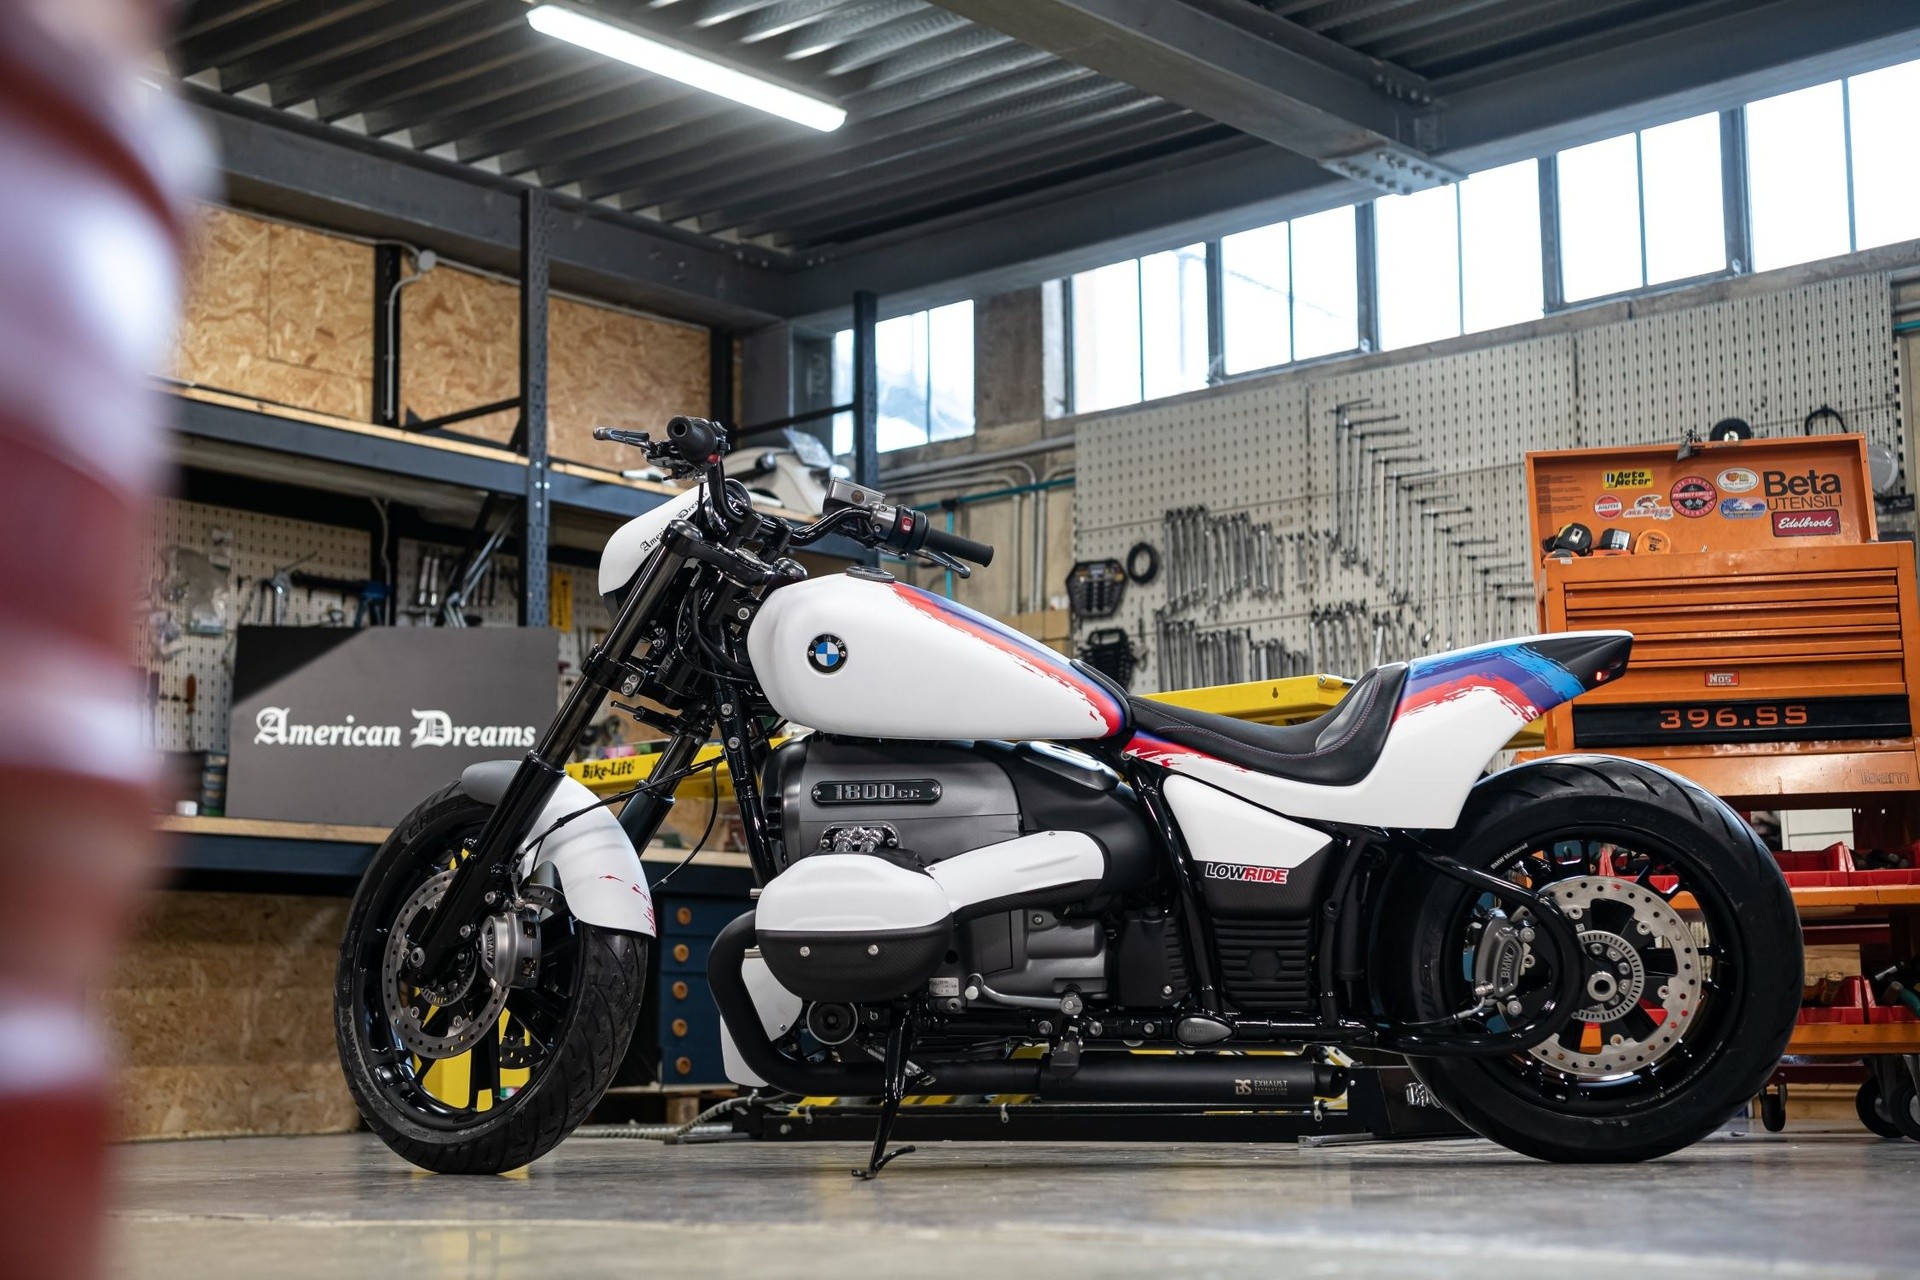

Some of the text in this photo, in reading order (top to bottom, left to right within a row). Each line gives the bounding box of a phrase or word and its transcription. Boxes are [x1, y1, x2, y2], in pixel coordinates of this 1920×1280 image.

[1615, 478, 1651, 488] Meter
[1617, 471, 1645, 479] Auto
[1763, 470, 1842, 498] Beta
[1766, 495, 1843, 511] UTENSILI
[1778, 516, 1833, 529] Edelbrock
[254, 706, 537, 749] American Dreams
[1660, 705, 1808, 729] 396.SS
[1204, 863, 1289, 885] LOWRIDE
[1501, 951, 1514, 978] BMW
